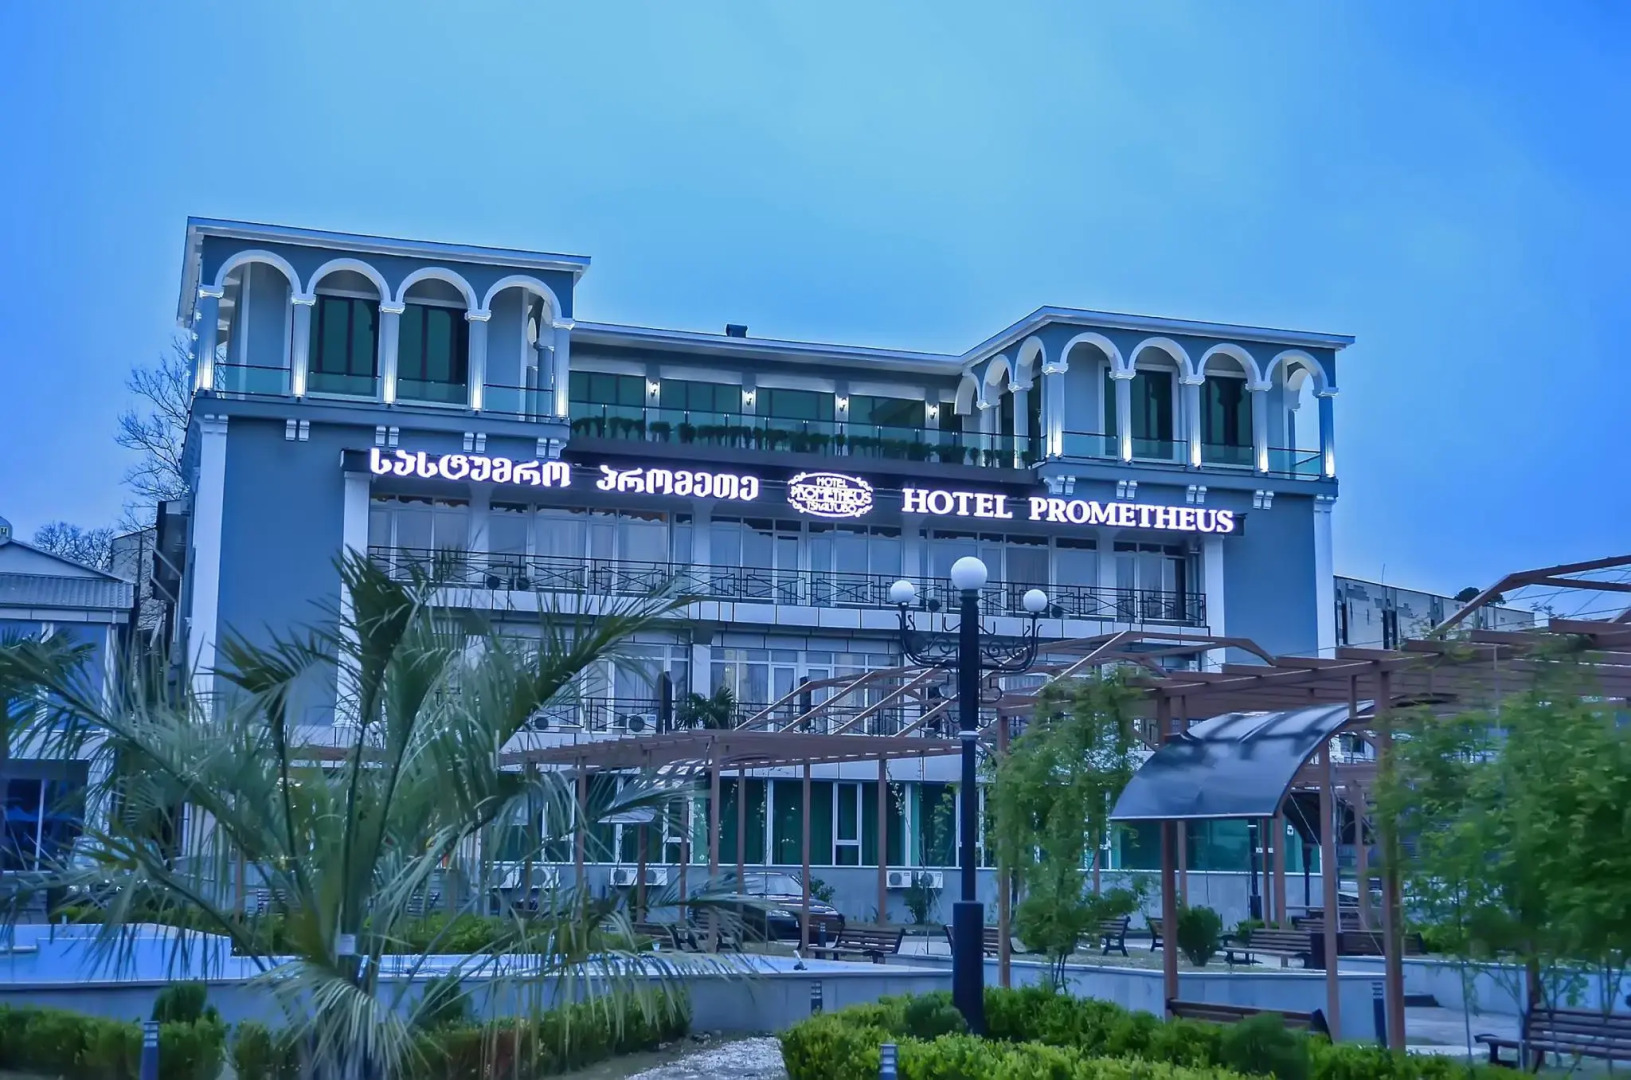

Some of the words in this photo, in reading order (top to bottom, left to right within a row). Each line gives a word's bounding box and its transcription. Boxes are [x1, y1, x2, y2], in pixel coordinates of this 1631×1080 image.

[370, 447, 571, 488] სასტუმრო
[596, 464, 759, 501] პრომეთე
[816, 477, 848, 488] HOTEL
[901, 488, 1013, 519] HOTEL
[1028, 496, 1235, 533] PROMETHEUS
